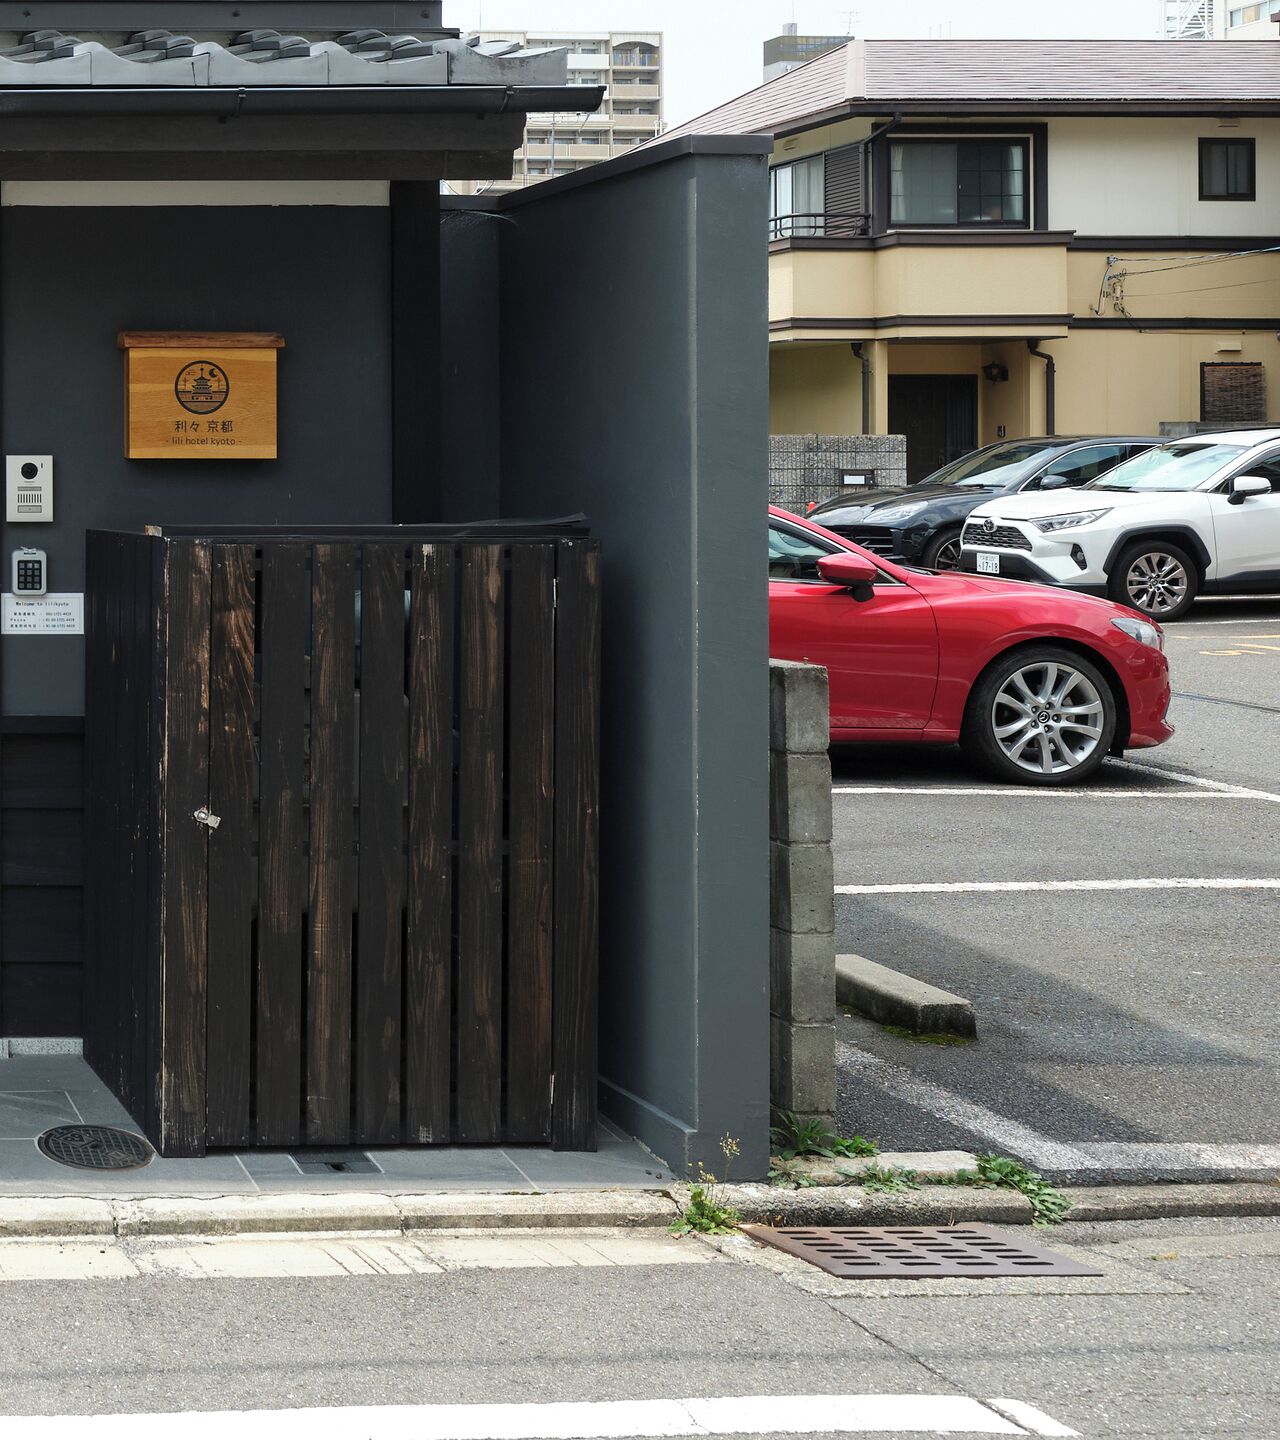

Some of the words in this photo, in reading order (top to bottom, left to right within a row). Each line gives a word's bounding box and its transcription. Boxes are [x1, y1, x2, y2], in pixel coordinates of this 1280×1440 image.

[175, 420, 200, 433] 利々
[207, 420, 233, 433] 京都
[172, 437, 183, 445] lili
[186, 437, 208, 445] hotel
[211, 437, 236, 446] kyoto
